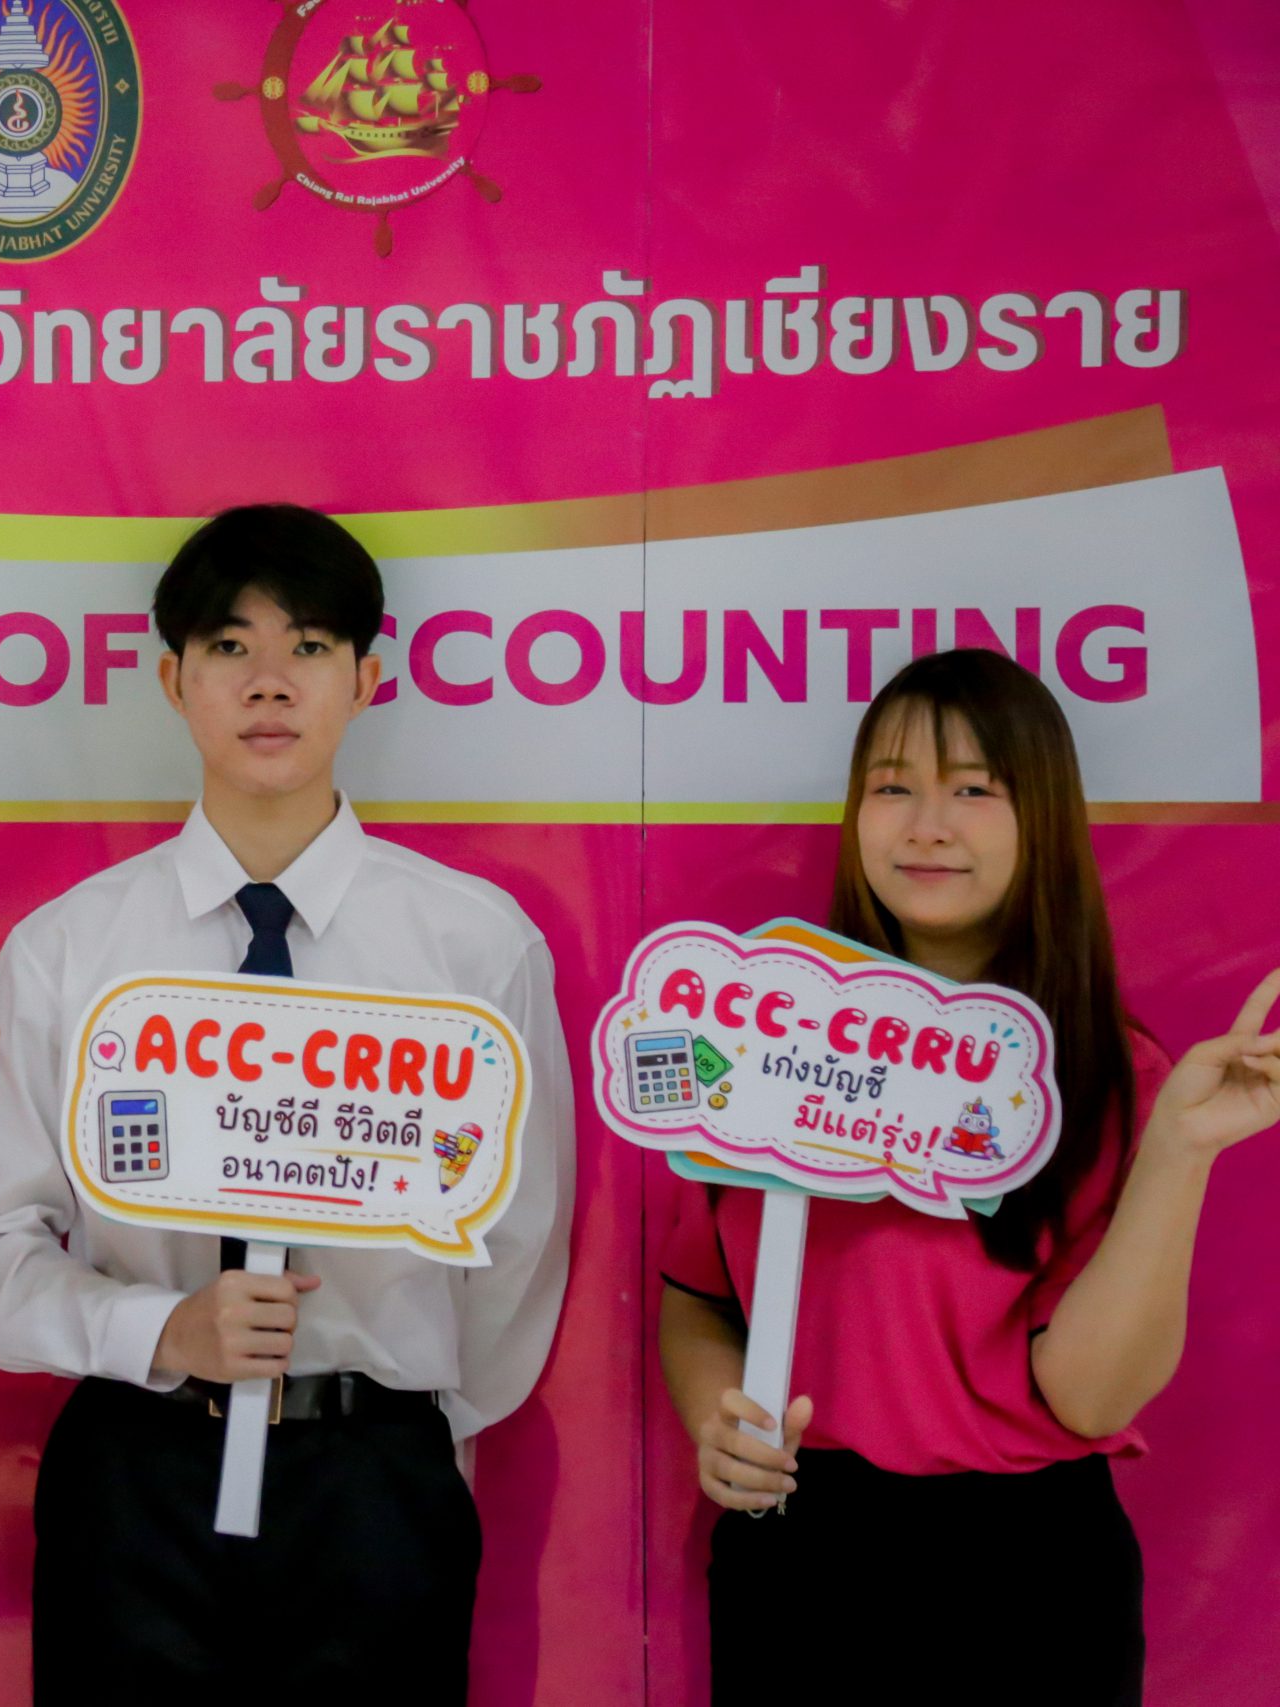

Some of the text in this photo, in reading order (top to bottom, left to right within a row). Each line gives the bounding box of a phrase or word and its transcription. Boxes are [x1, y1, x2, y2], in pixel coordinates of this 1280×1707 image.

[66, 134, 126, 230] UNIVERSITY
[296, 156, 465, 206] Chiang Rai Rajabhat University
[369, 604, 1148, 707] COUNTING
[135, 1014, 474, 1101] ACC-CRRU
[659, 968, 1001, 1083] ACC-CRRU
[762, 1045, 888, 1103] เก่งบัญชี
[216, 1093, 423, 1147] บัญชีดี ชีวิตดี
[794, 1094, 942, 1164] มีแต่รุ่ง!
[222, 1154, 379, 1192] อนาคตปัง!
